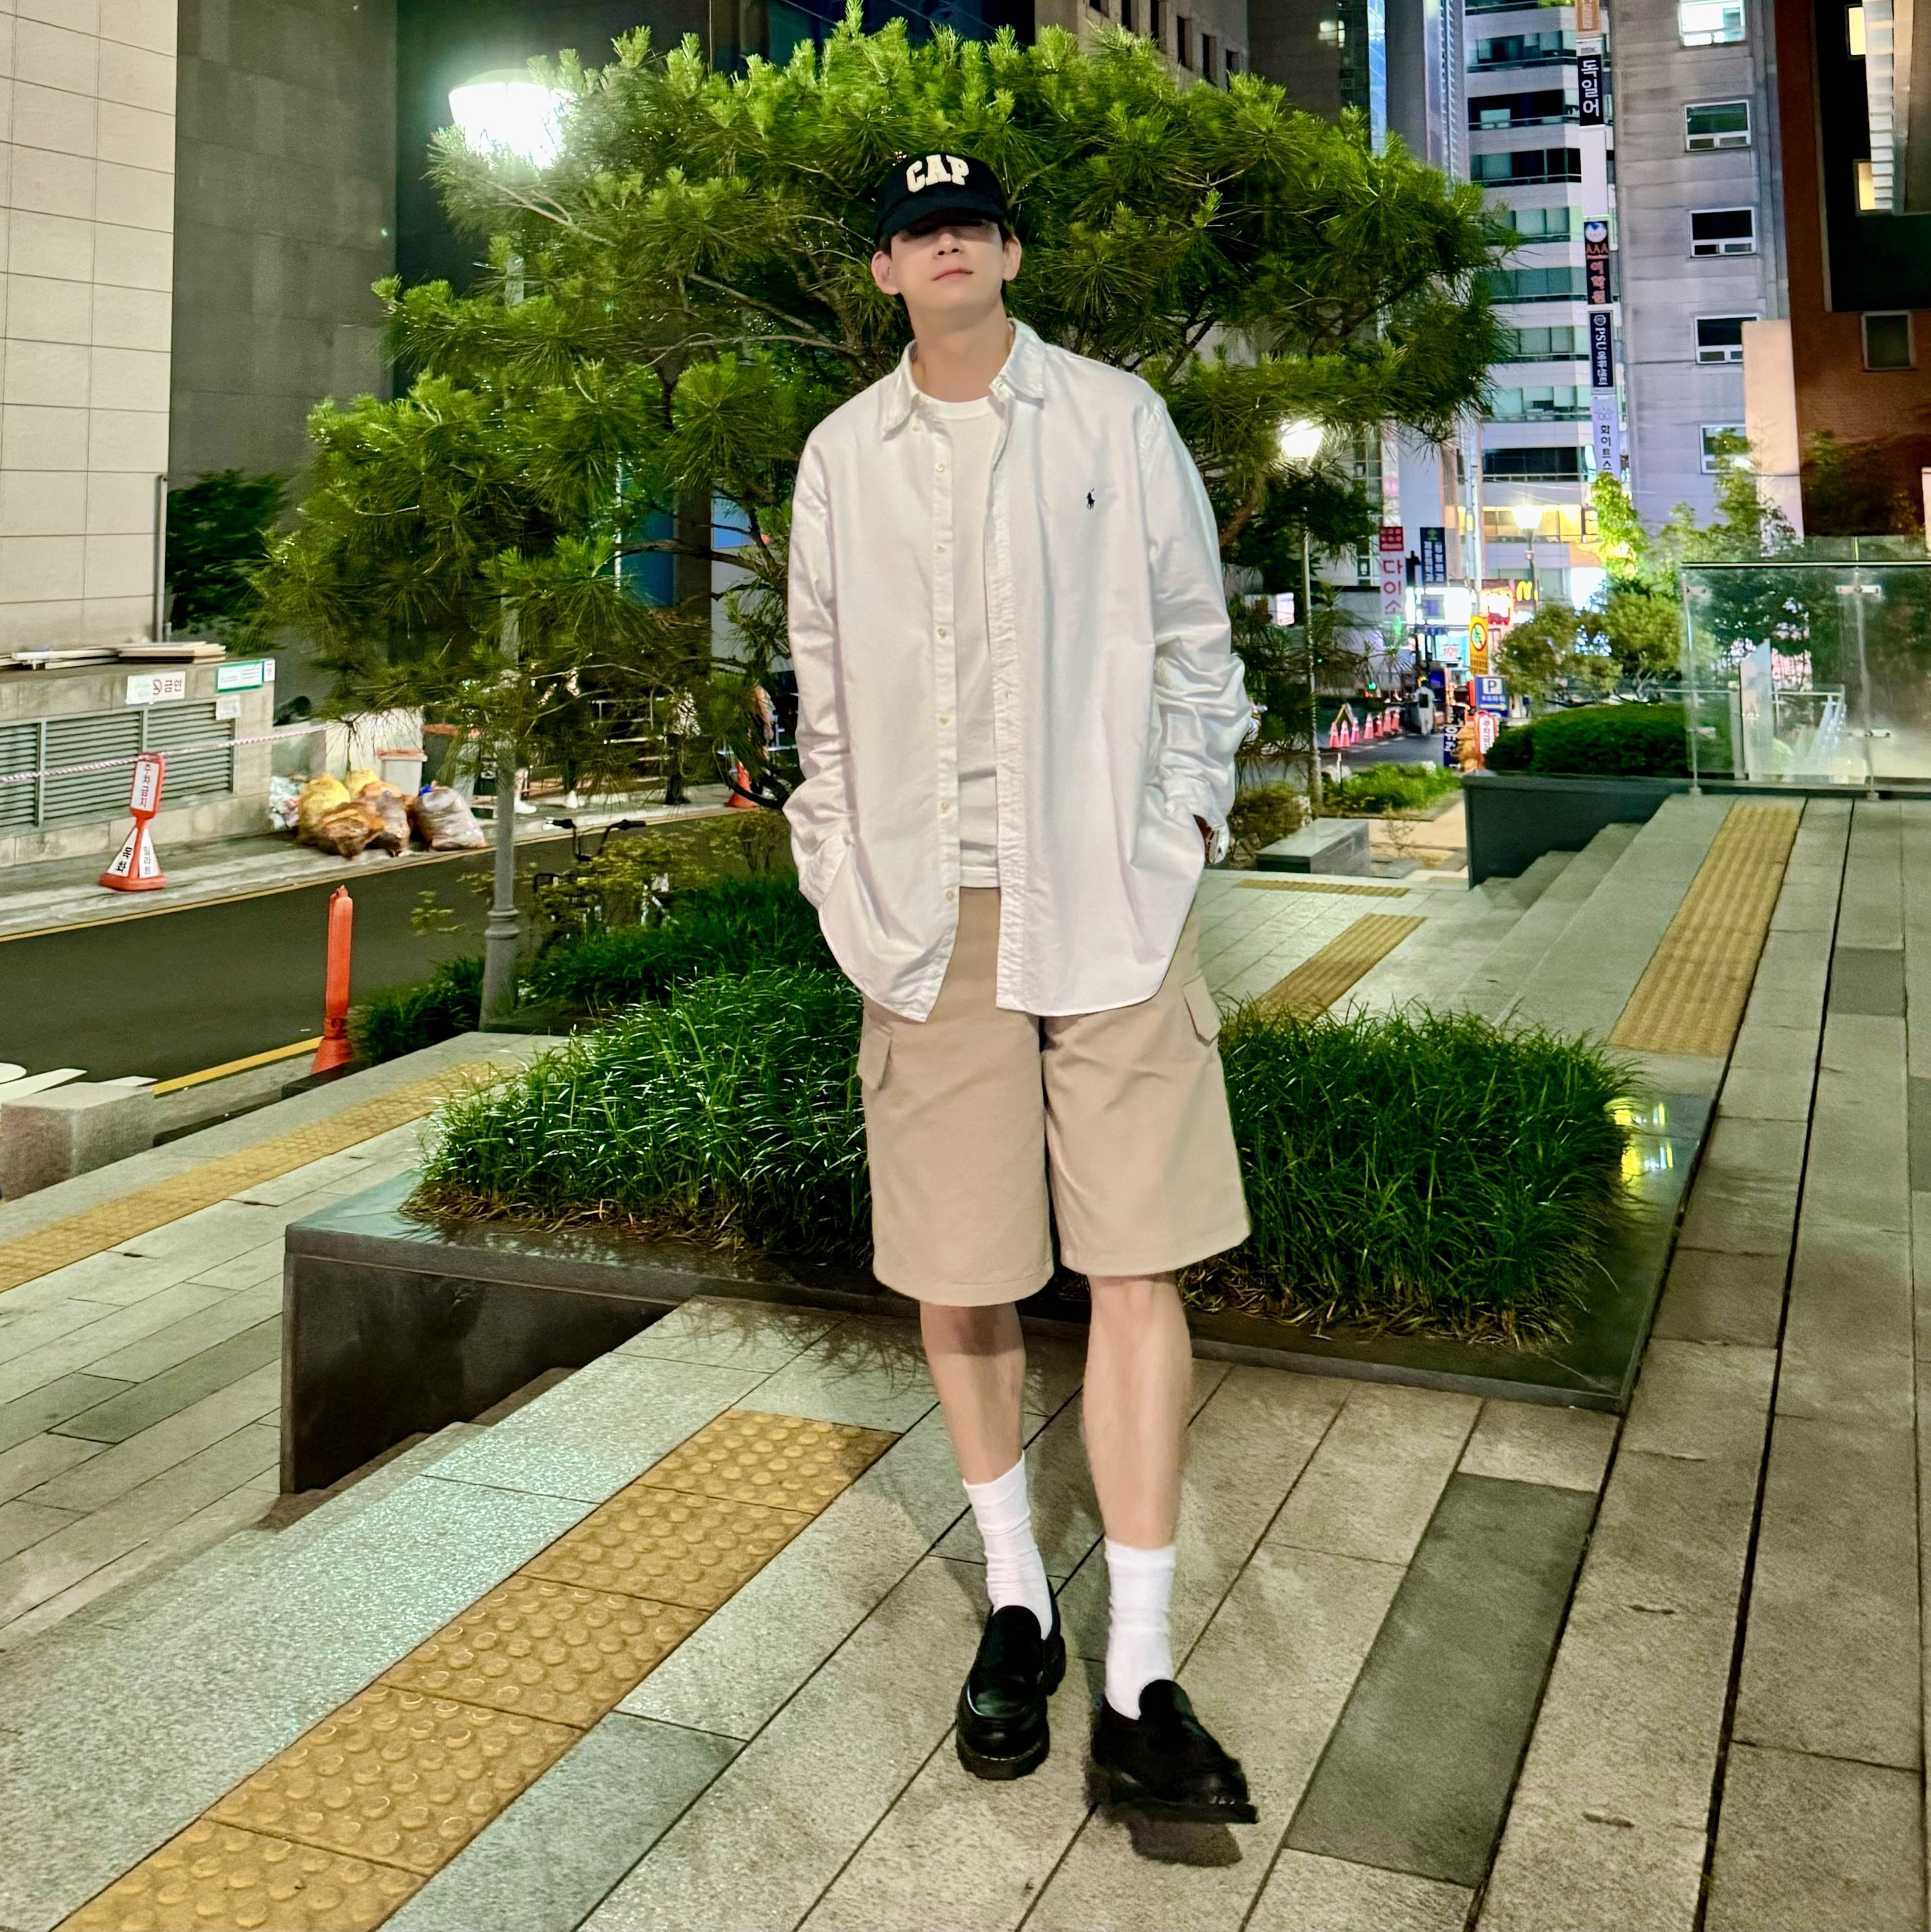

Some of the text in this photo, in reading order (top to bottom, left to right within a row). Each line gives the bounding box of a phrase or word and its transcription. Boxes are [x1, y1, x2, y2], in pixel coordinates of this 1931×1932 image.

[1581, 59, 1600, 117] 독일어
[1383, 558, 1403, 614] 다이소
[164, 679, 182, 693] 금연
[1488, 680, 1497, 692] P
[140, 763, 152, 808] 주차금지
